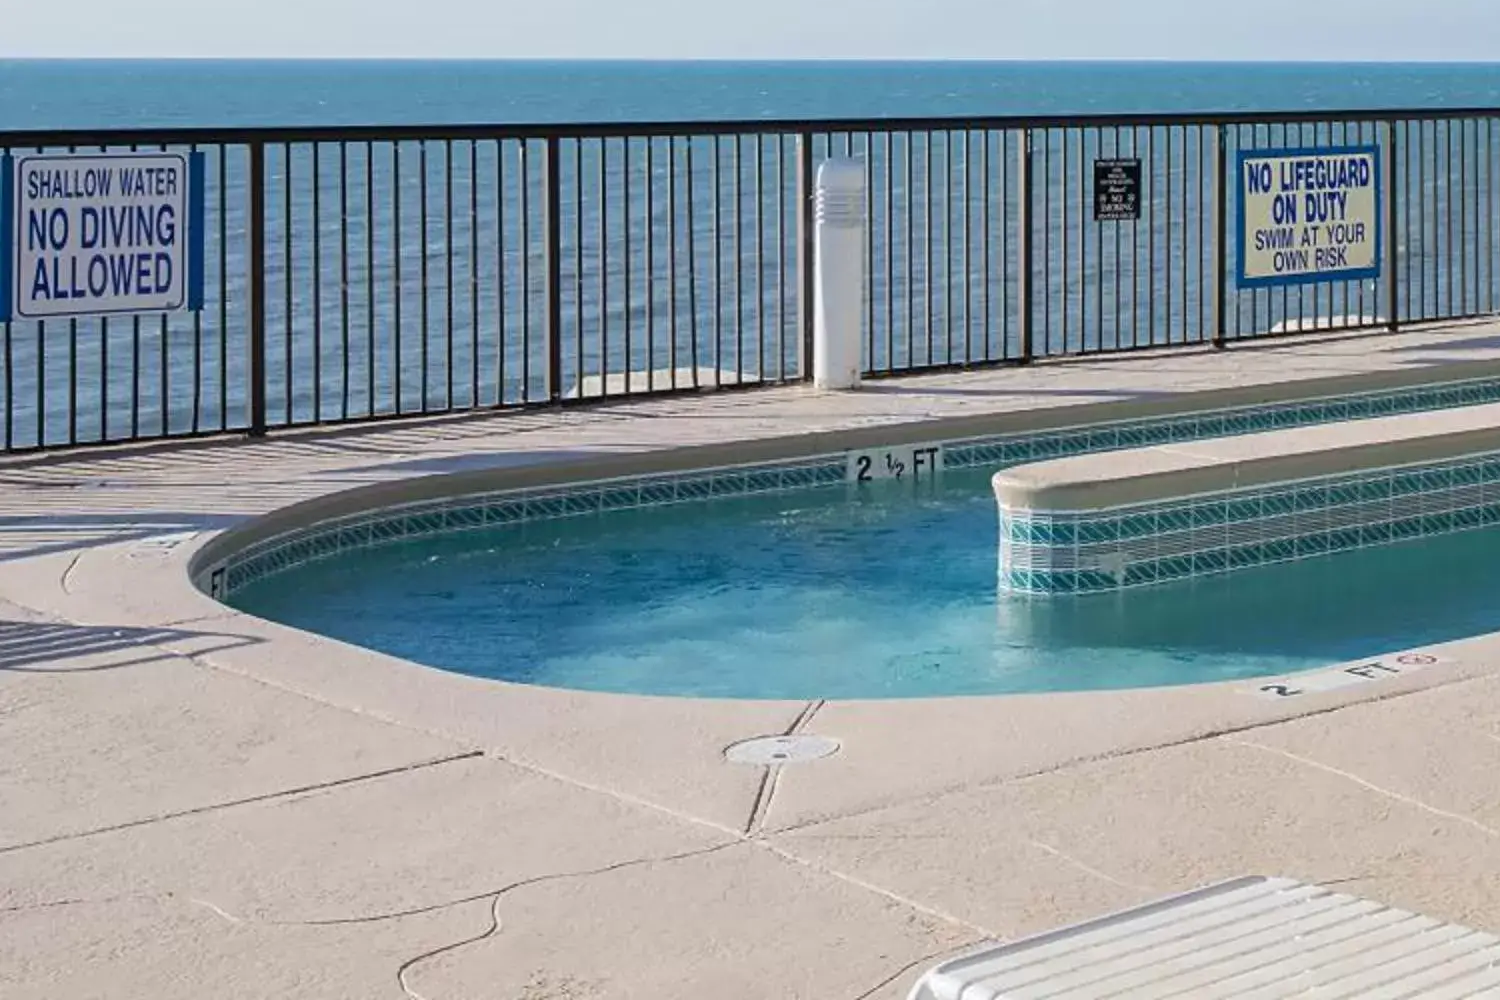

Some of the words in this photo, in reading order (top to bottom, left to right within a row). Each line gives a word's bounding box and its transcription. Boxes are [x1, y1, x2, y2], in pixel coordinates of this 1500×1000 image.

[27, 168, 112, 200] SHALLOW
[120, 168, 177, 196] WATER
[1248, 162, 1272, 194] NO
[1281, 158, 1369, 191] LIFEGUARD
[1273, 194, 1296, 224] ON
[1305, 191, 1347, 222] DUTY
[29, 207, 68, 251] NO
[81, 204, 175, 249] DIVING
[1255, 227, 1294, 250] SWIM
[1301, 225, 1320, 246] AT
[1327, 223, 1365, 244] YOUR
[32, 252, 172, 300] ALLOWED
[1273, 250, 1309, 272] OWN
[1316, 246, 1347, 269] RISK
[857, 455, 873, 481] 2
[914, 447, 939, 476] FT
[1260, 684, 1303, 697] 2
[1345, 661, 1400, 679] FT
